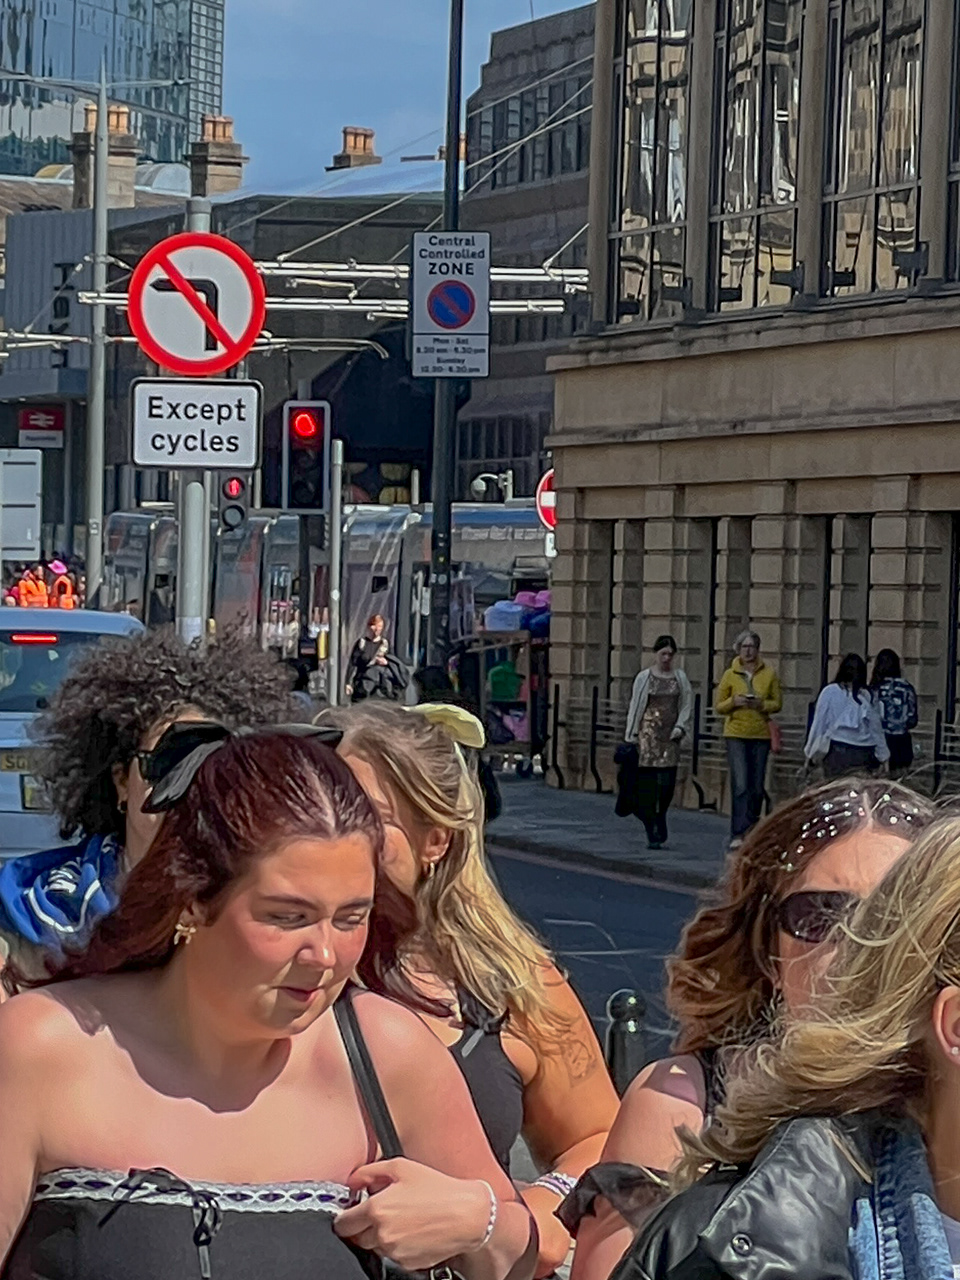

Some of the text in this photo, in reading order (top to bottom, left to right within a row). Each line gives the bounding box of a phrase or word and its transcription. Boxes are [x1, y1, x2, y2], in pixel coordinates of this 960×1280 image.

[429, 235, 476, 246] Central
[419, 248, 485, 259] Controlled
[428, 262, 474, 275] ZONE
[147, 395, 246, 425] Except
[150, 428, 239, 455] cycles
